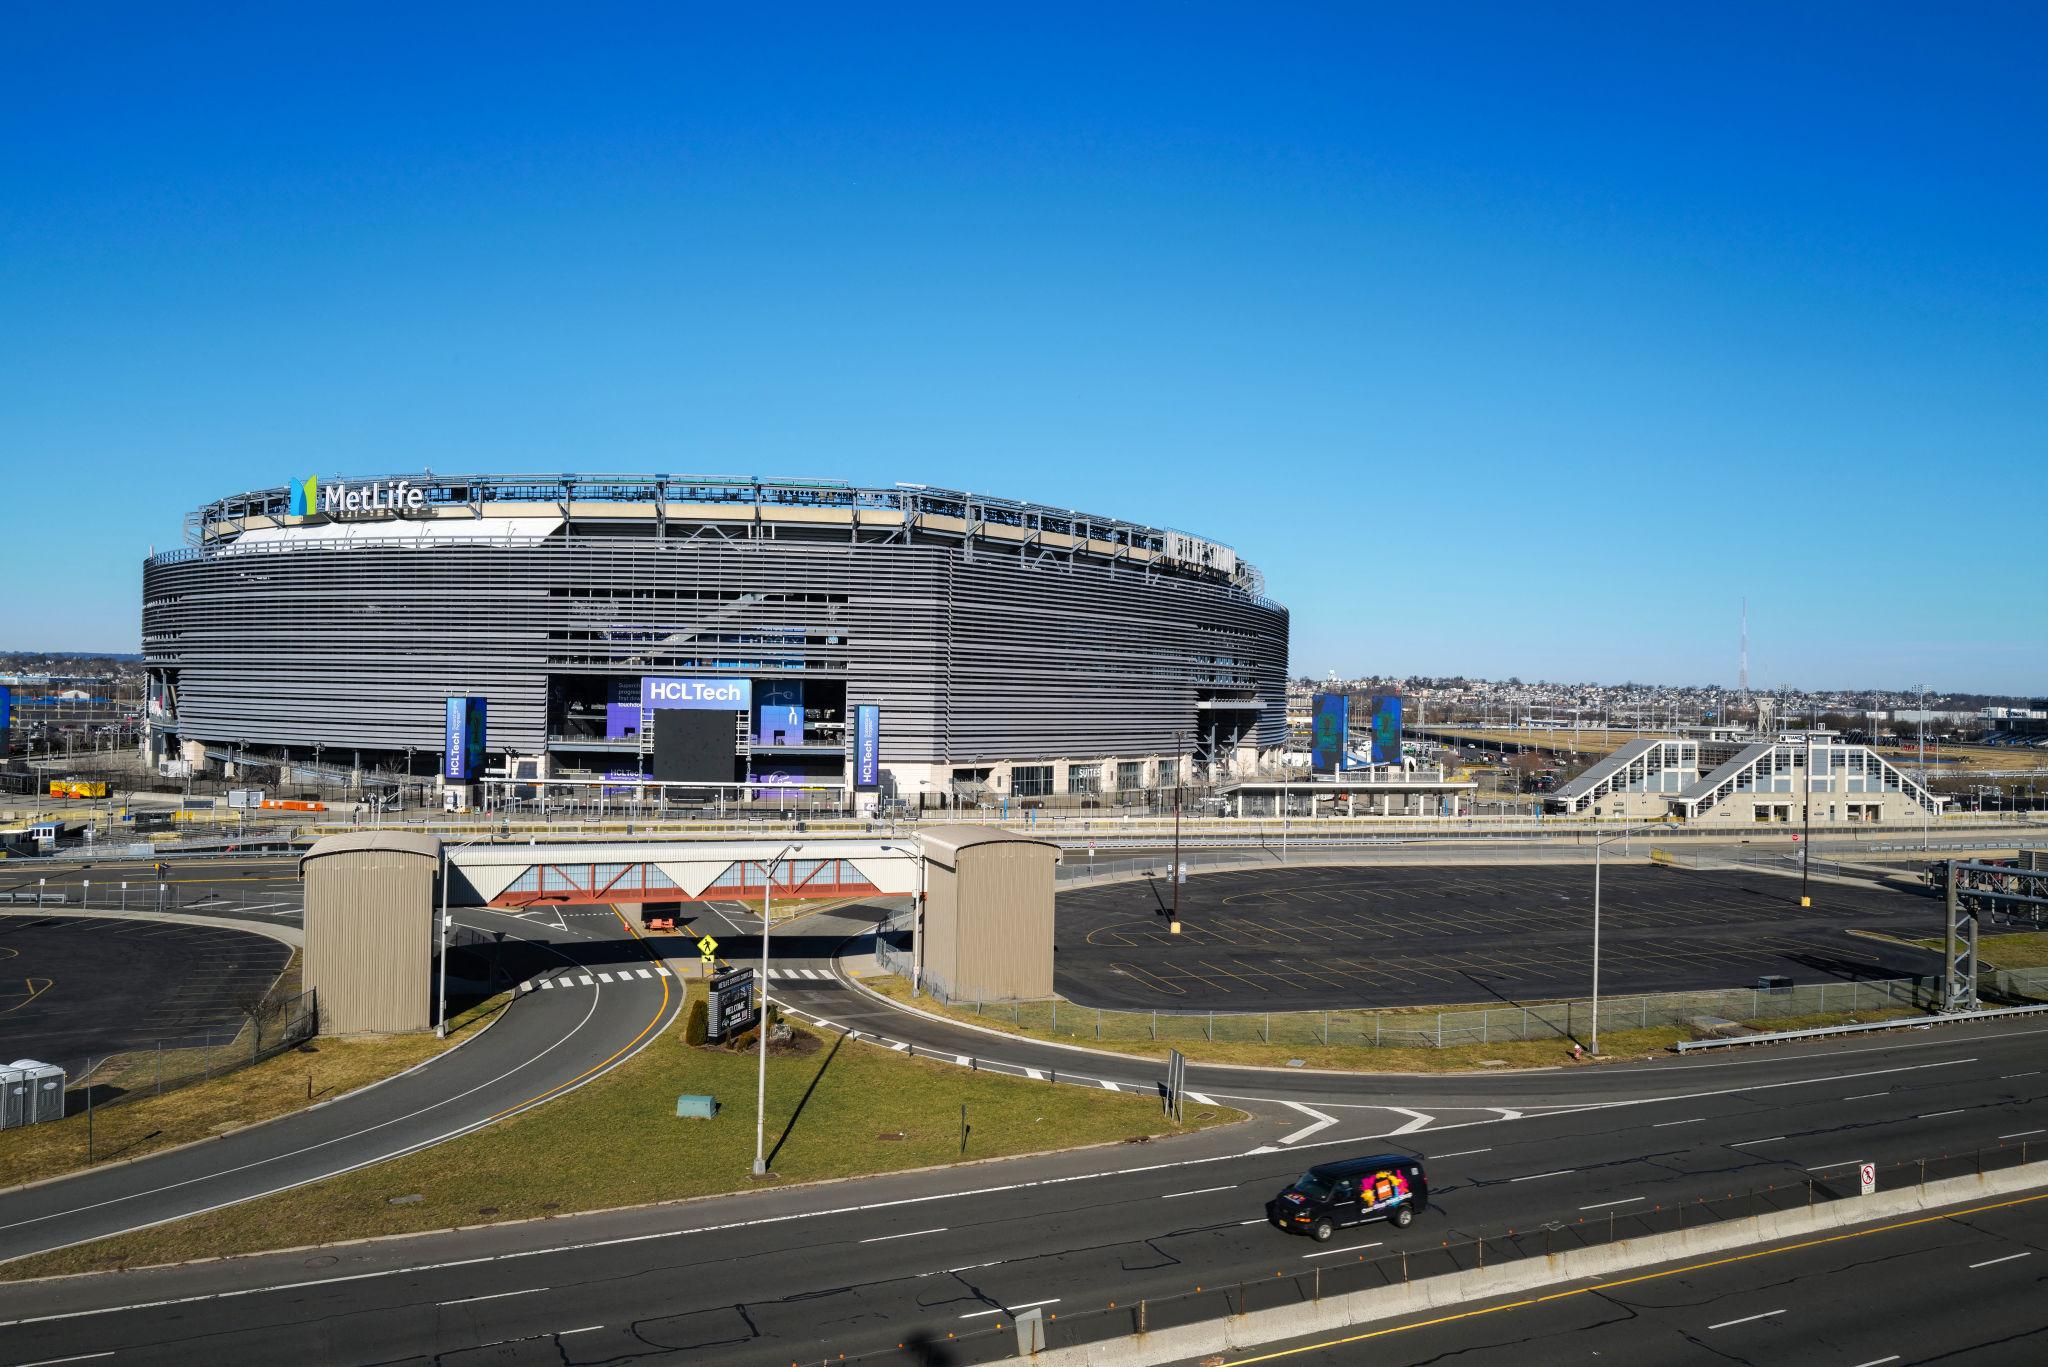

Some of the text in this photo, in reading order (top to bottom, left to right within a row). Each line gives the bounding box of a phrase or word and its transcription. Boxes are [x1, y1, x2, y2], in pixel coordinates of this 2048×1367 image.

[325, 481, 423, 511] MetLife
[650, 683, 740, 701] HCLTech
[451, 733, 460, 775] HCLTech
[864, 741, 872, 782] HCLTech
[1078, 768, 1101, 778] SUITES
[726, 1001, 745, 1015] WELCOME
